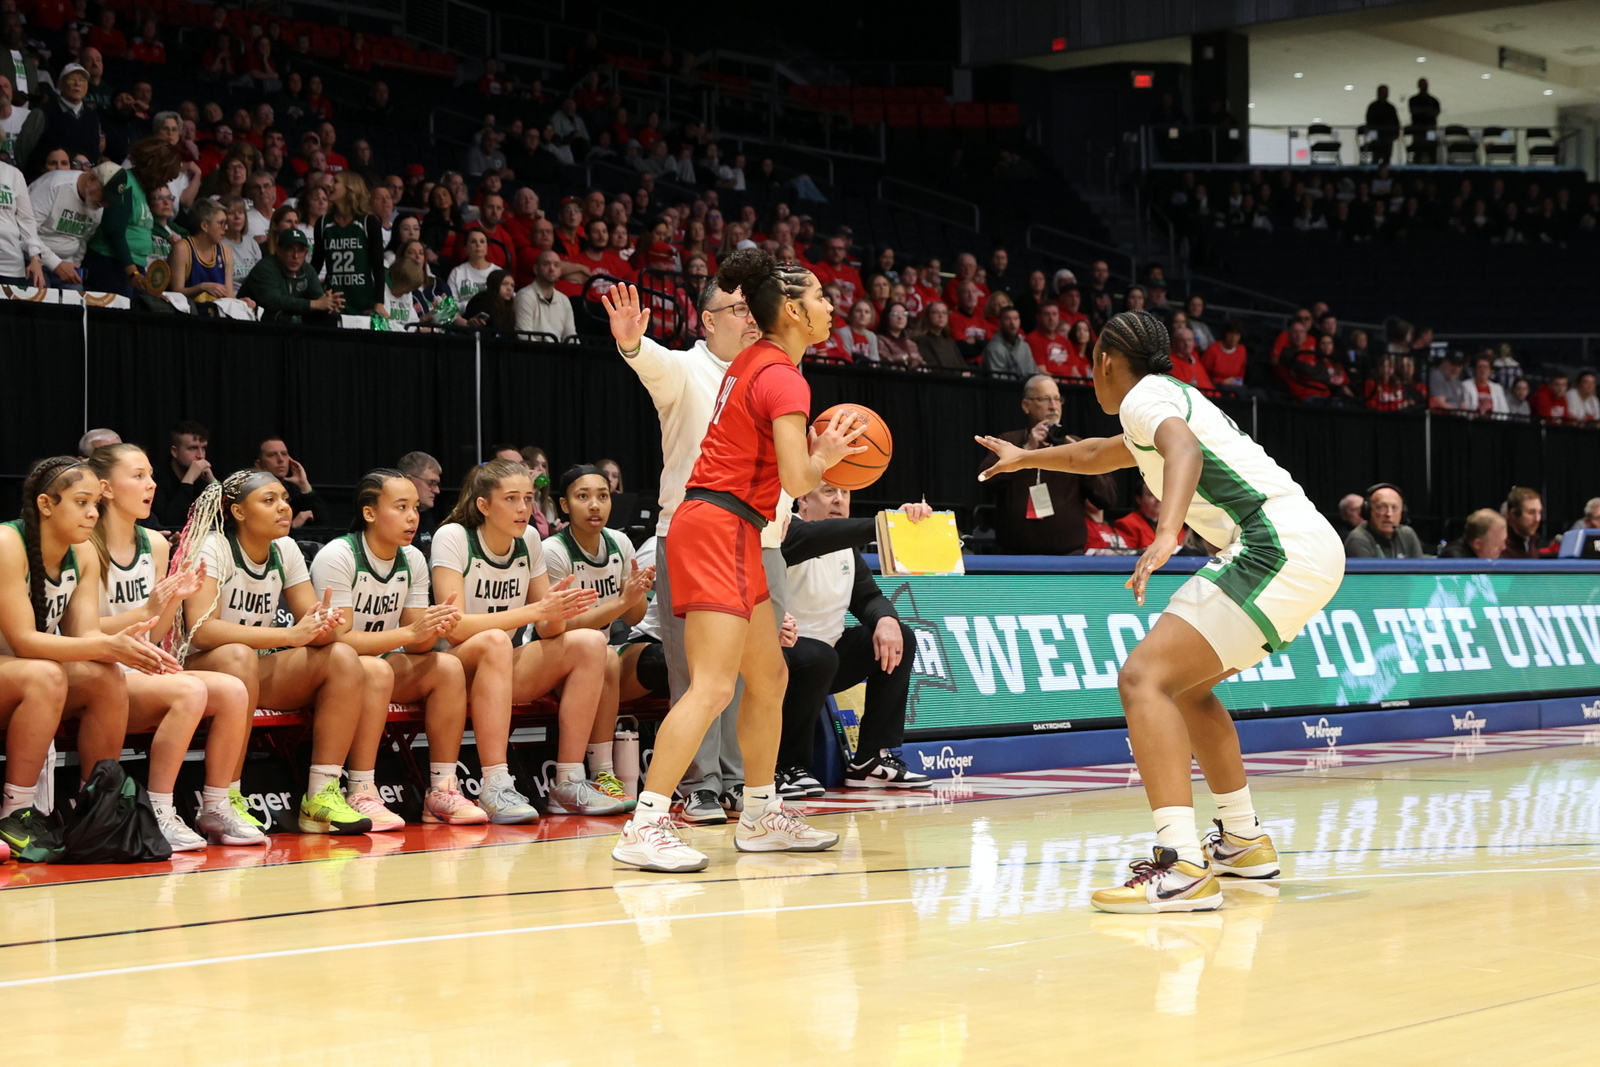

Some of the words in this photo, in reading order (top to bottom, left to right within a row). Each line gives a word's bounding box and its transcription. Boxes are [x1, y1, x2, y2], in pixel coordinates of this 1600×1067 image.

[324, 237, 363, 250] LAUREL
[331, 250, 355, 273] 22
[328, 273, 366, 286] ATORS
[109, 576, 149, 604] AURE
[475, 578, 521, 600] LAUREL
[228, 588, 273, 614] LAURE
[354, 592, 399, 615] LAUREL
[1297, 609, 1377, 677] TO
[1373, 606, 1492, 675] THE
[1032, 721, 1072, 731] DAKTRONICS
[1315, 717, 1343, 746] Kroger
[936, 746, 974, 778] Kroger
